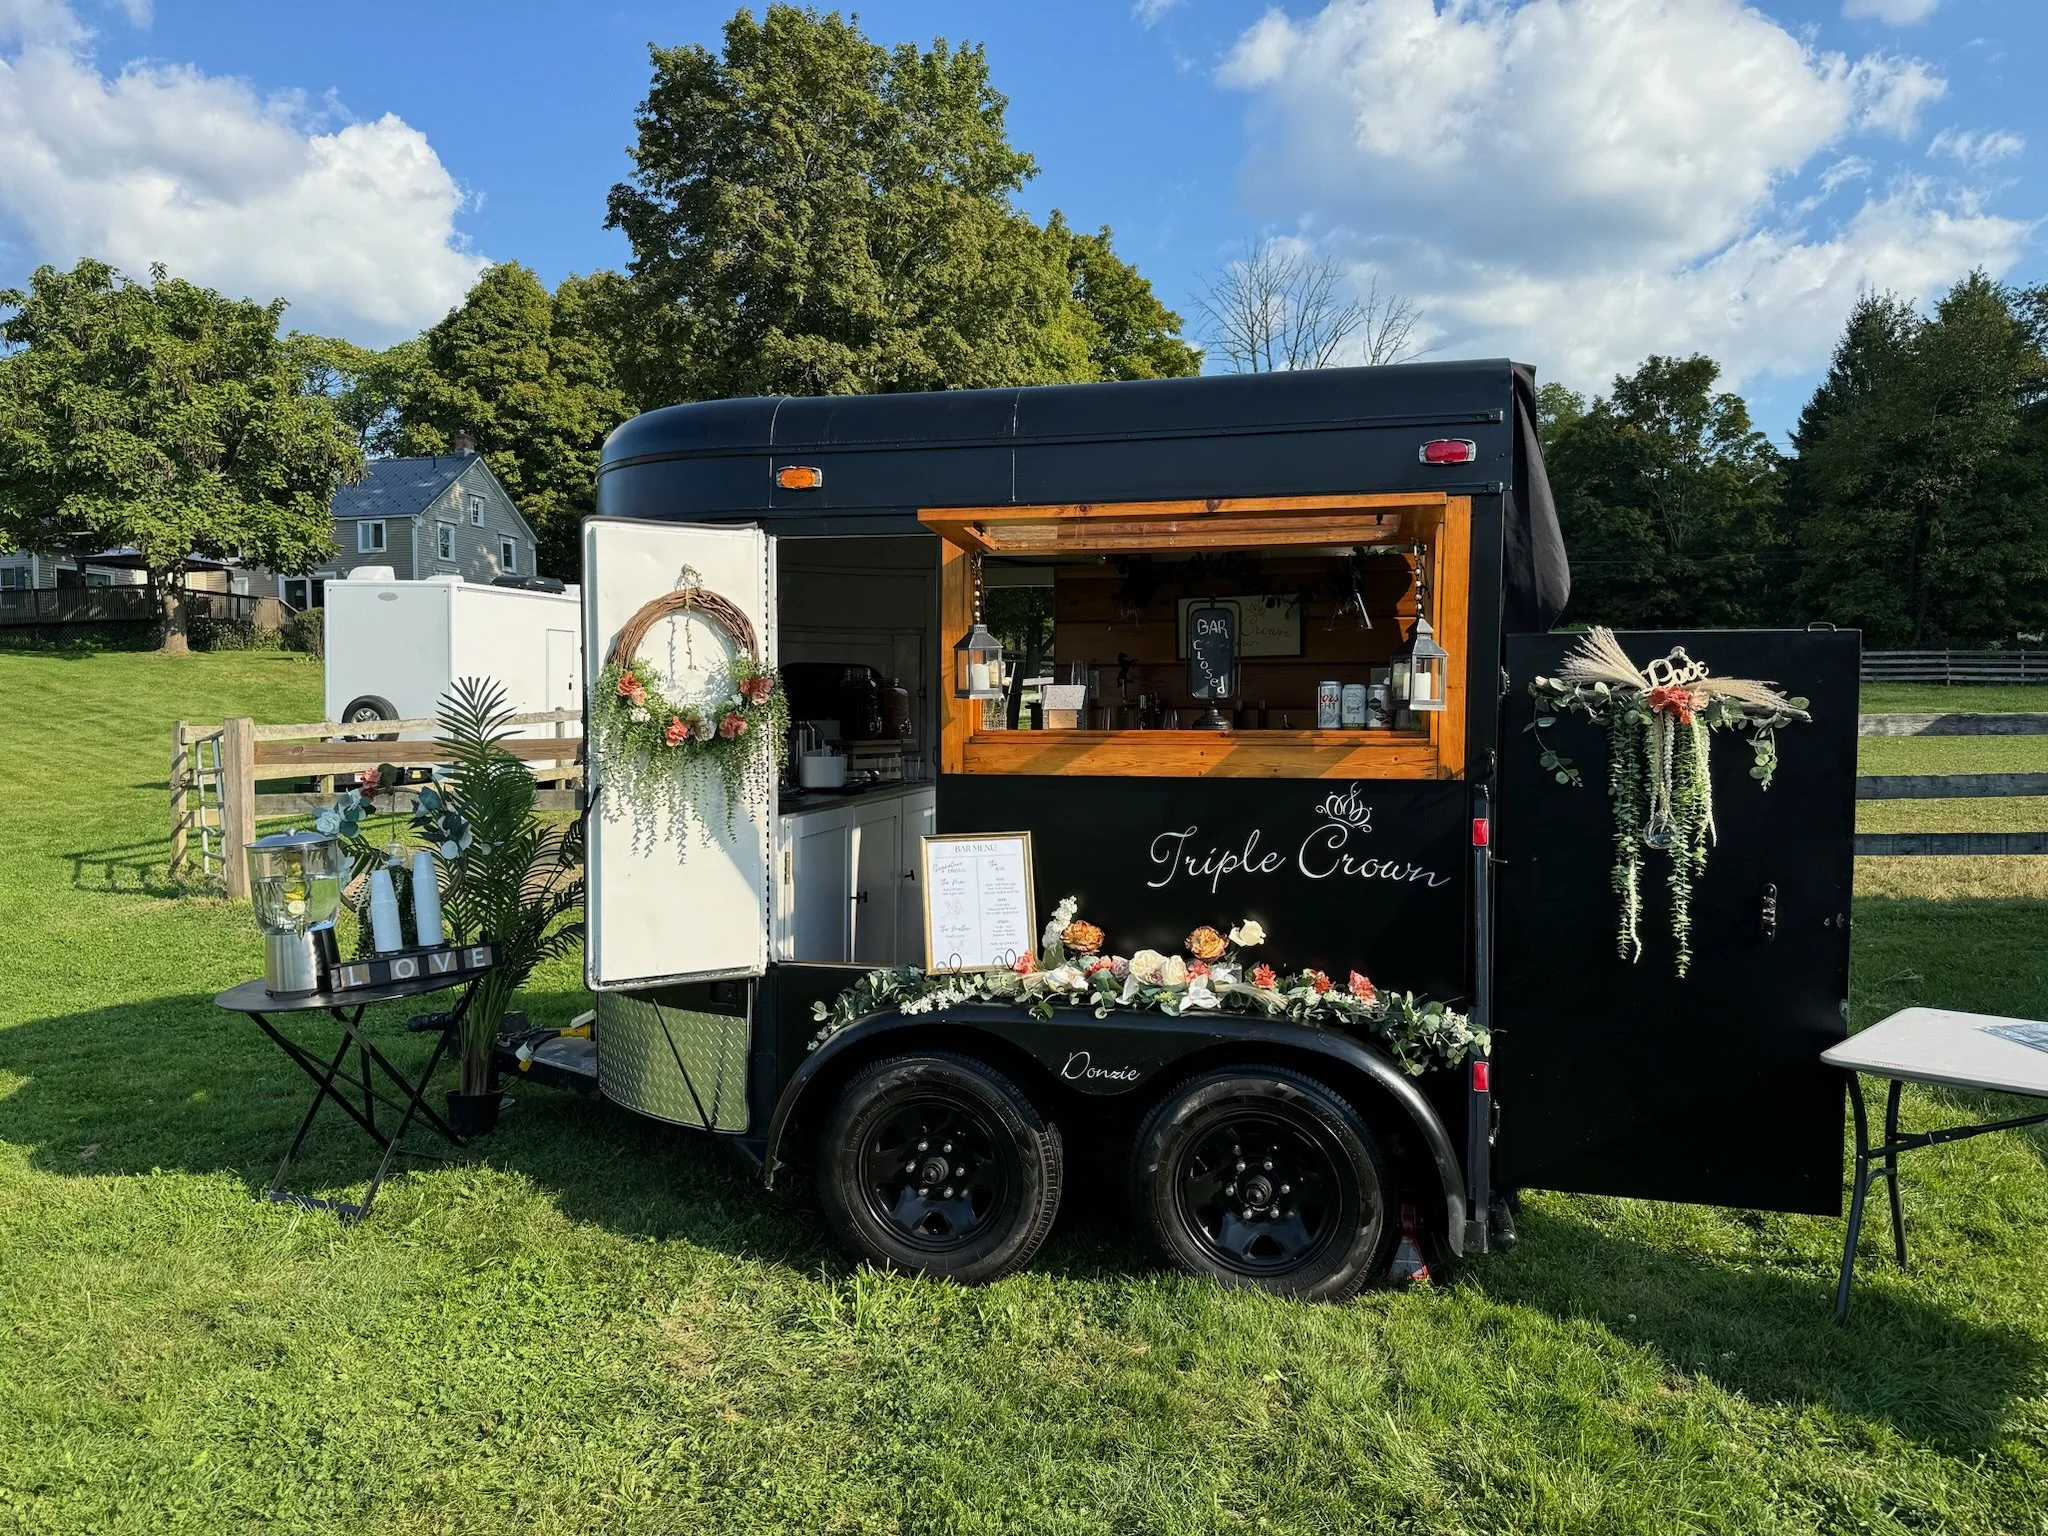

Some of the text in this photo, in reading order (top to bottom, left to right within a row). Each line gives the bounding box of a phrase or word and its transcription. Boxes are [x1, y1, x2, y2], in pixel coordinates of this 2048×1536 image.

[1197, 619, 1229, 639] BAR
[955, 843, 995, 853] BAR MENU
[1147, 823, 1450, 893] Triple Crown
[347, 947, 486, 987] LOVE
[1061, 1051, 1140, 1081] Donzie
